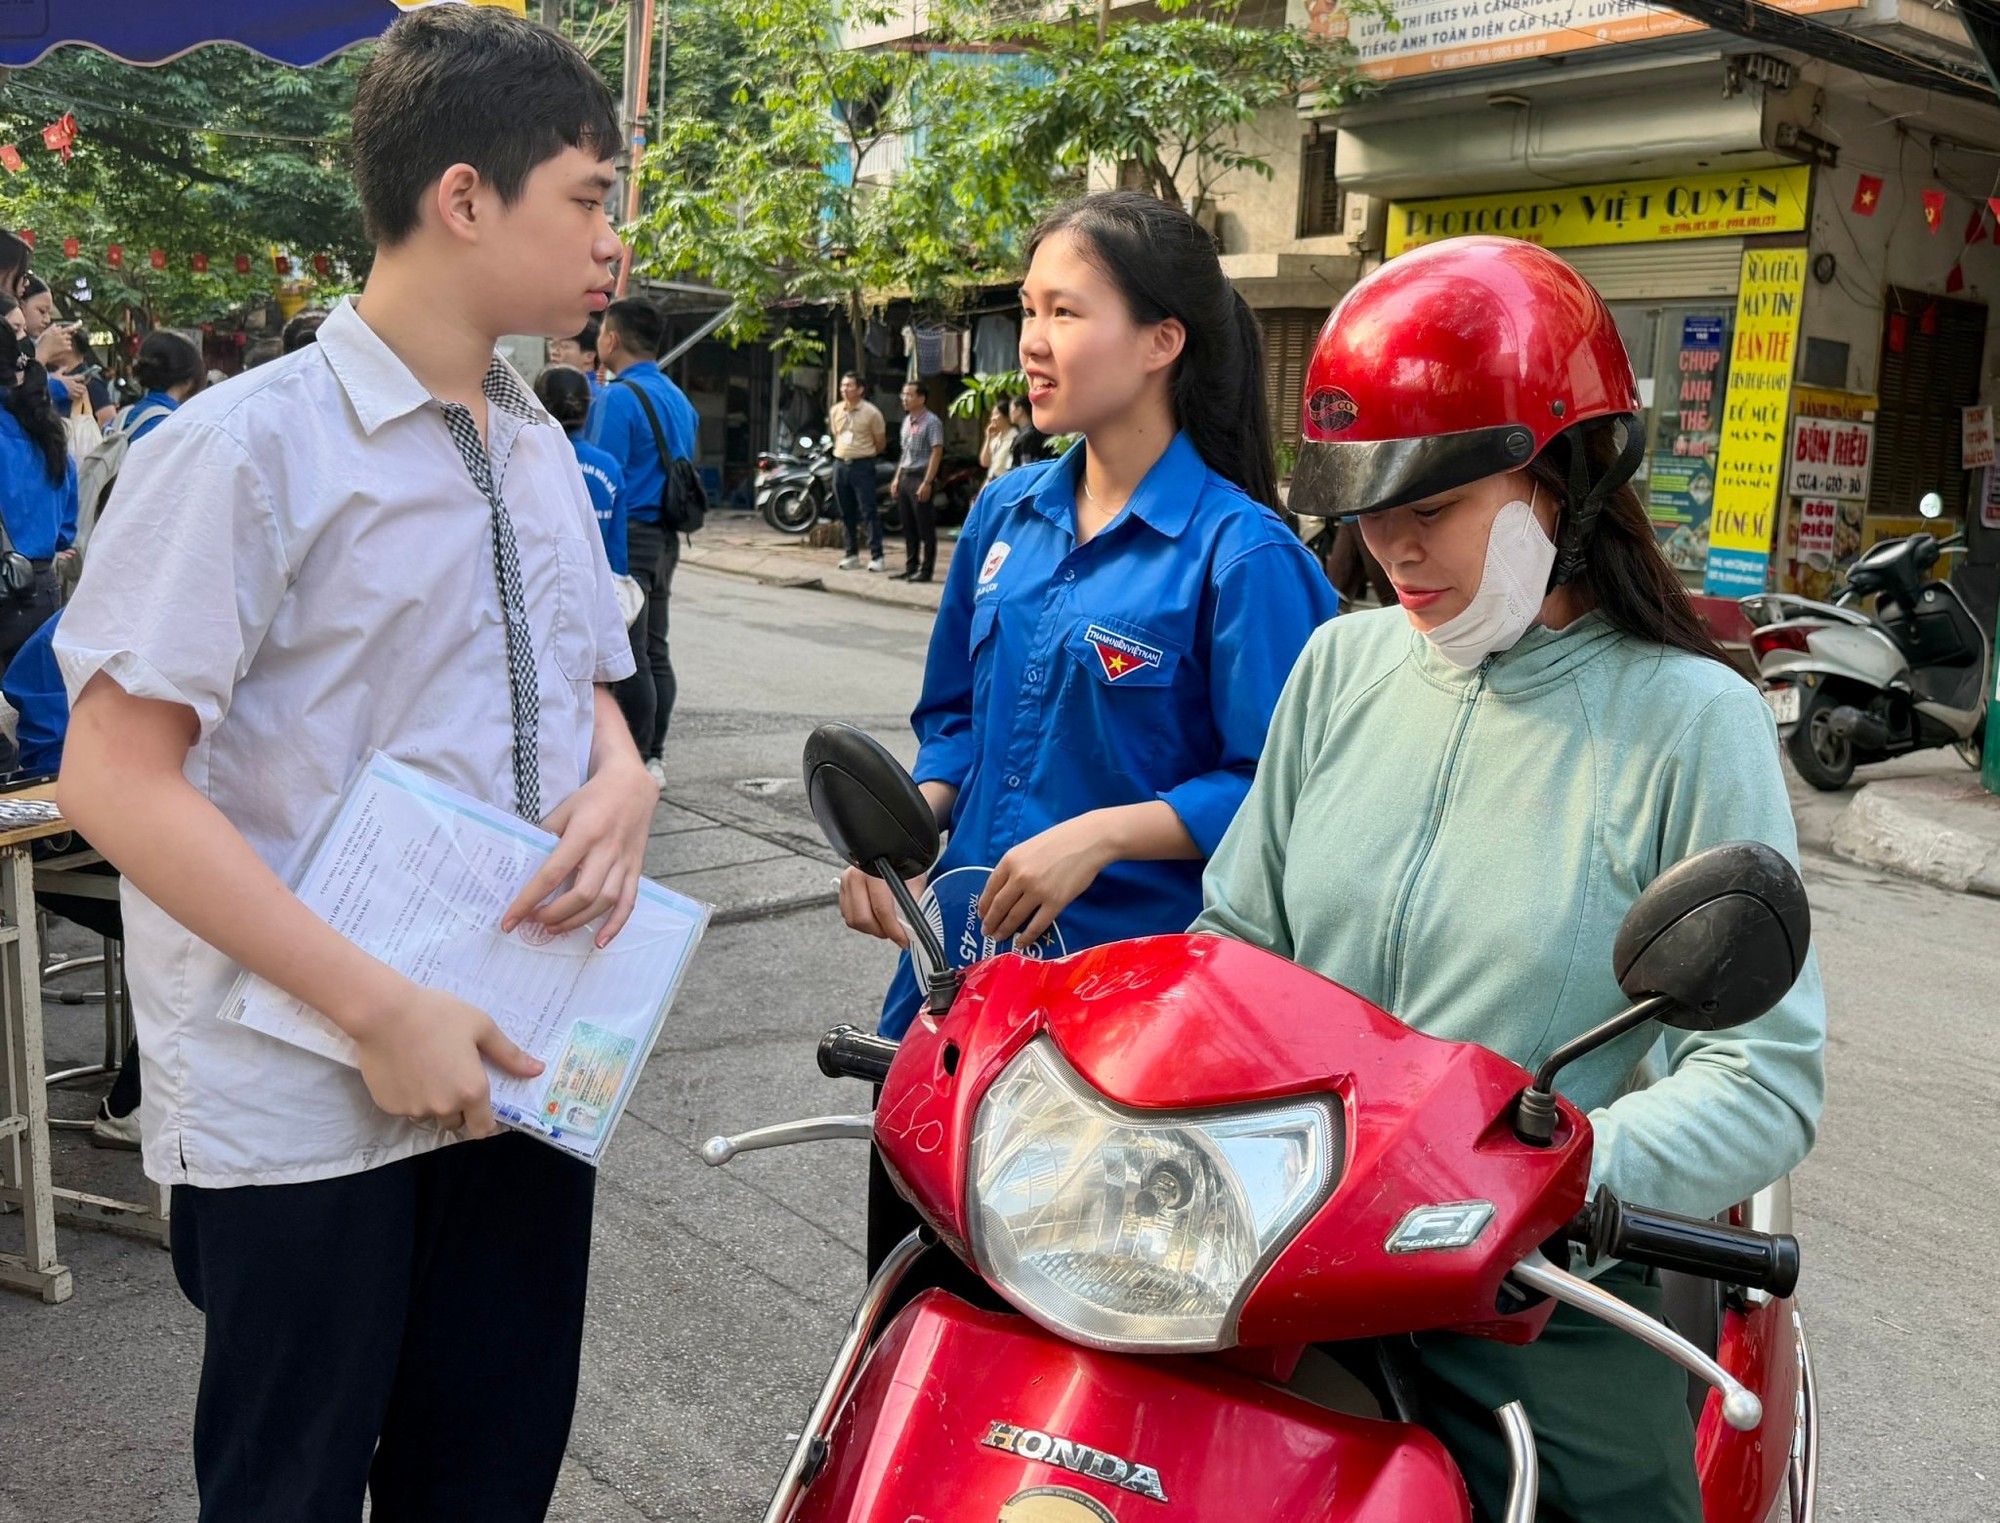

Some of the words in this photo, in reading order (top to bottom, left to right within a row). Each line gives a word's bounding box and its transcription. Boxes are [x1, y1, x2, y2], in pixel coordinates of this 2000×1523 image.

[1361, 14, 1396, 37] LUY
[1402, 15, 1421, 30] THI
[1425, 8, 1458, 25] IELTS
[1462, 2, 1479, 18] VÀ
[1361, 38, 1397, 57] TIẾNG
[1400, 34, 1428, 51] ANH
[1432, 28, 1467, 45] TOÀN
[1471, 21, 1504, 40] DIỆN
[1508, 15, 1537, 32] CẤP
[1406, 202, 1567, 236] PHOTOCOPY
[1579, 190, 1654, 229] VIỆT
[1679, 351, 1720, 375] CHỤP
[1680, 373, 1712, 400] ẢNH
[1680, 403, 1708, 431] THẺ
[1795, 421, 1831, 463] BÚN
[1833, 426, 1868, 467] RIÊU
[1796, 474, 1818, 491] CUA
[1825, 472, 1842, 491] GIÒ
[341, 880, 354, 897] THPT
[965, 892, 978, 931] TRONG
[959, 930, 978, 963] 45
[1402, 1210, 1484, 1237] FI
[981, 1420, 1169, 1502] HONDA
